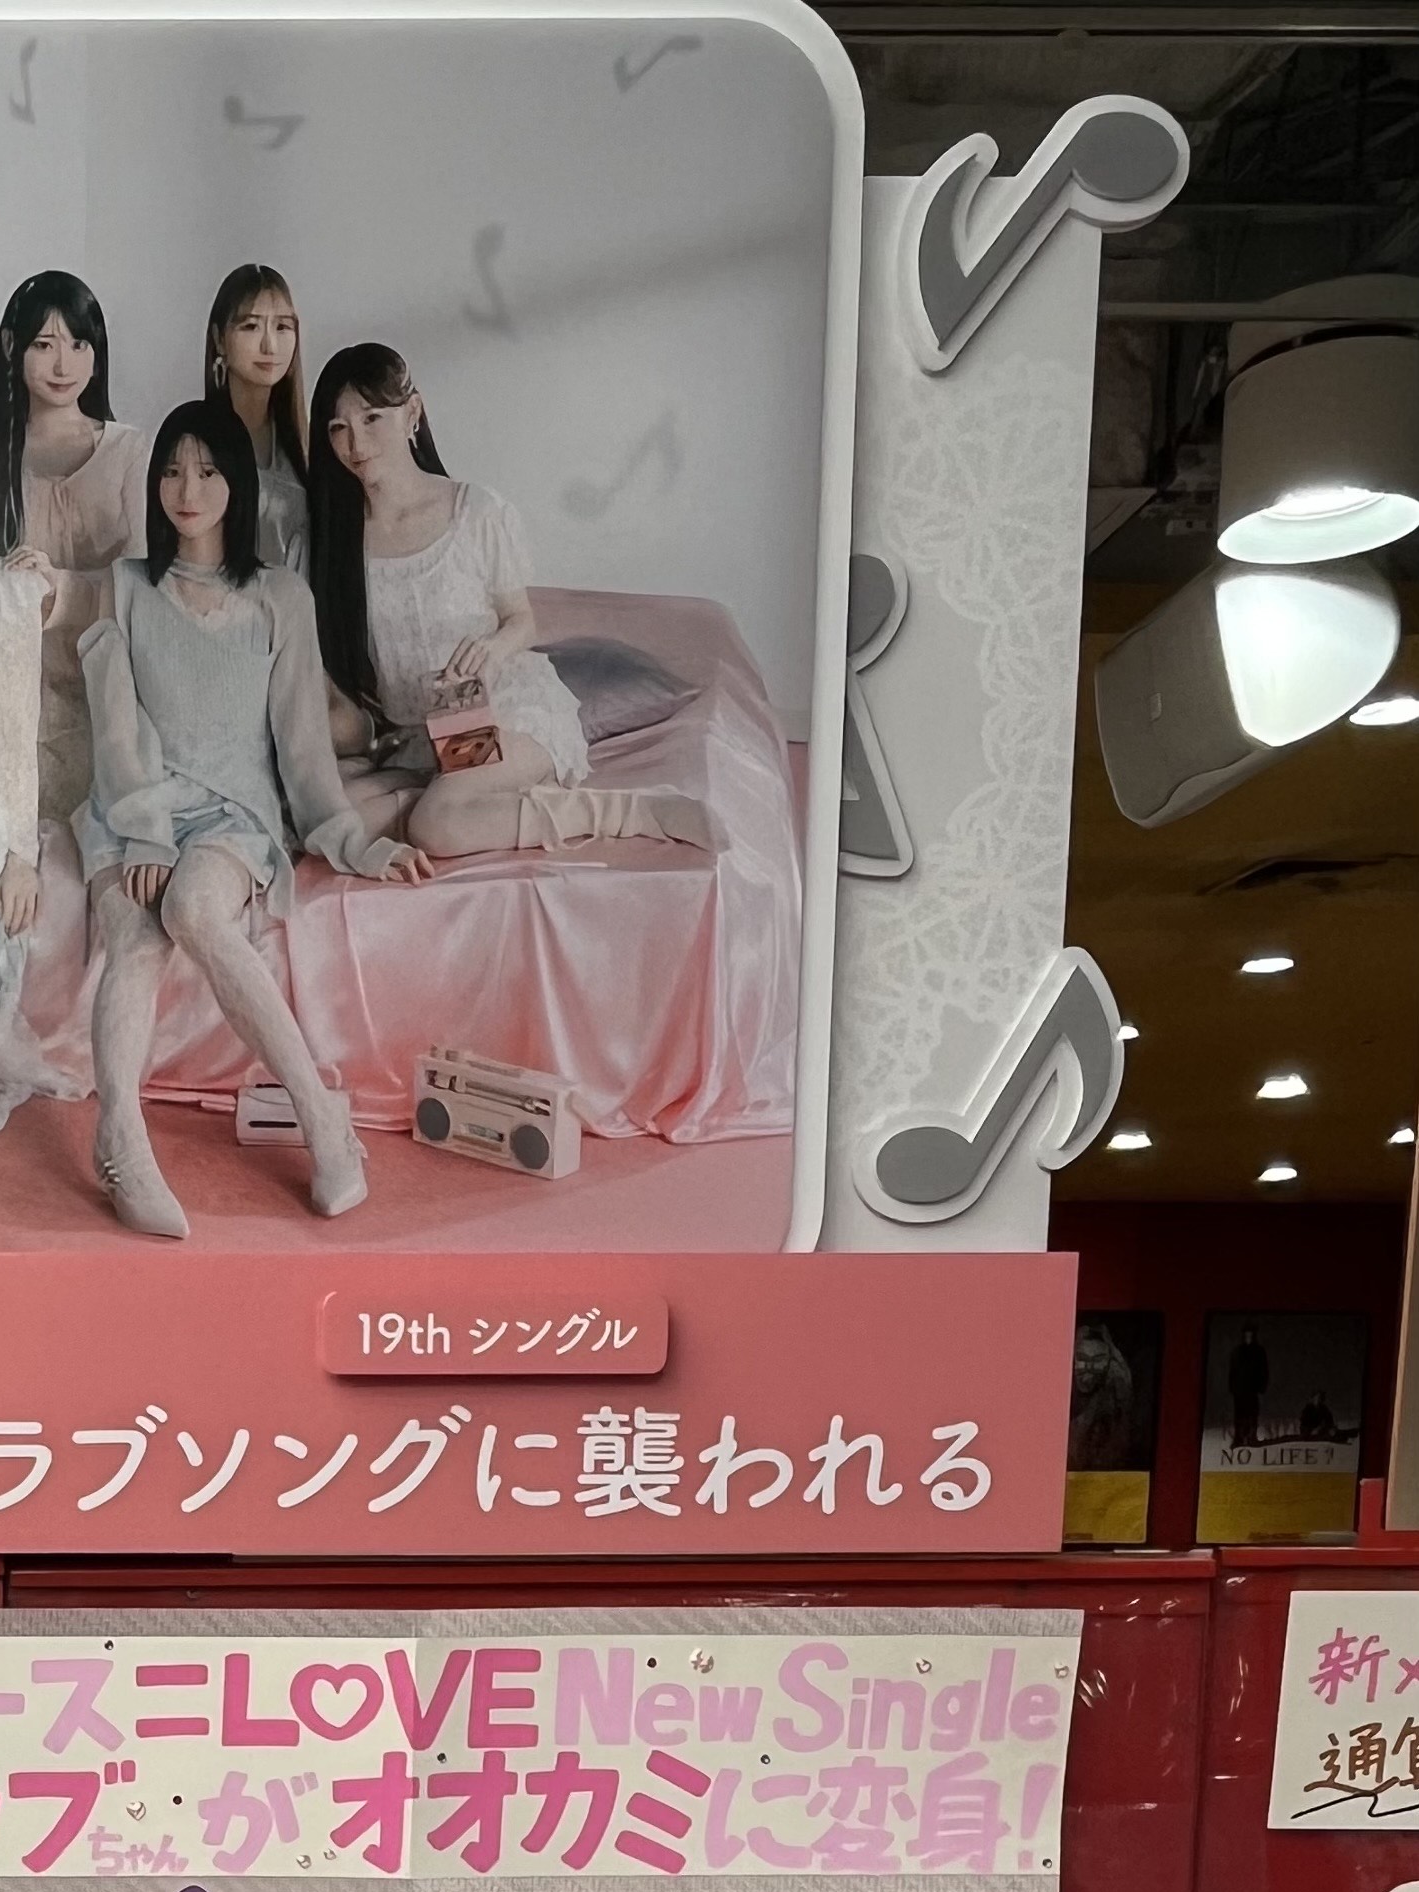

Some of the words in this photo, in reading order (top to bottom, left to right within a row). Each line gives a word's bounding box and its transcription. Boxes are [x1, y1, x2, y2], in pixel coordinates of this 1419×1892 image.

[356, 1311, 451, 1355] 19th
[467, 1305, 639, 1356] シングル
[1220, 1448, 1252, 1466] NO
[553, 1646, 763, 1747] New
[772, 1642, 1061, 1754] Single
